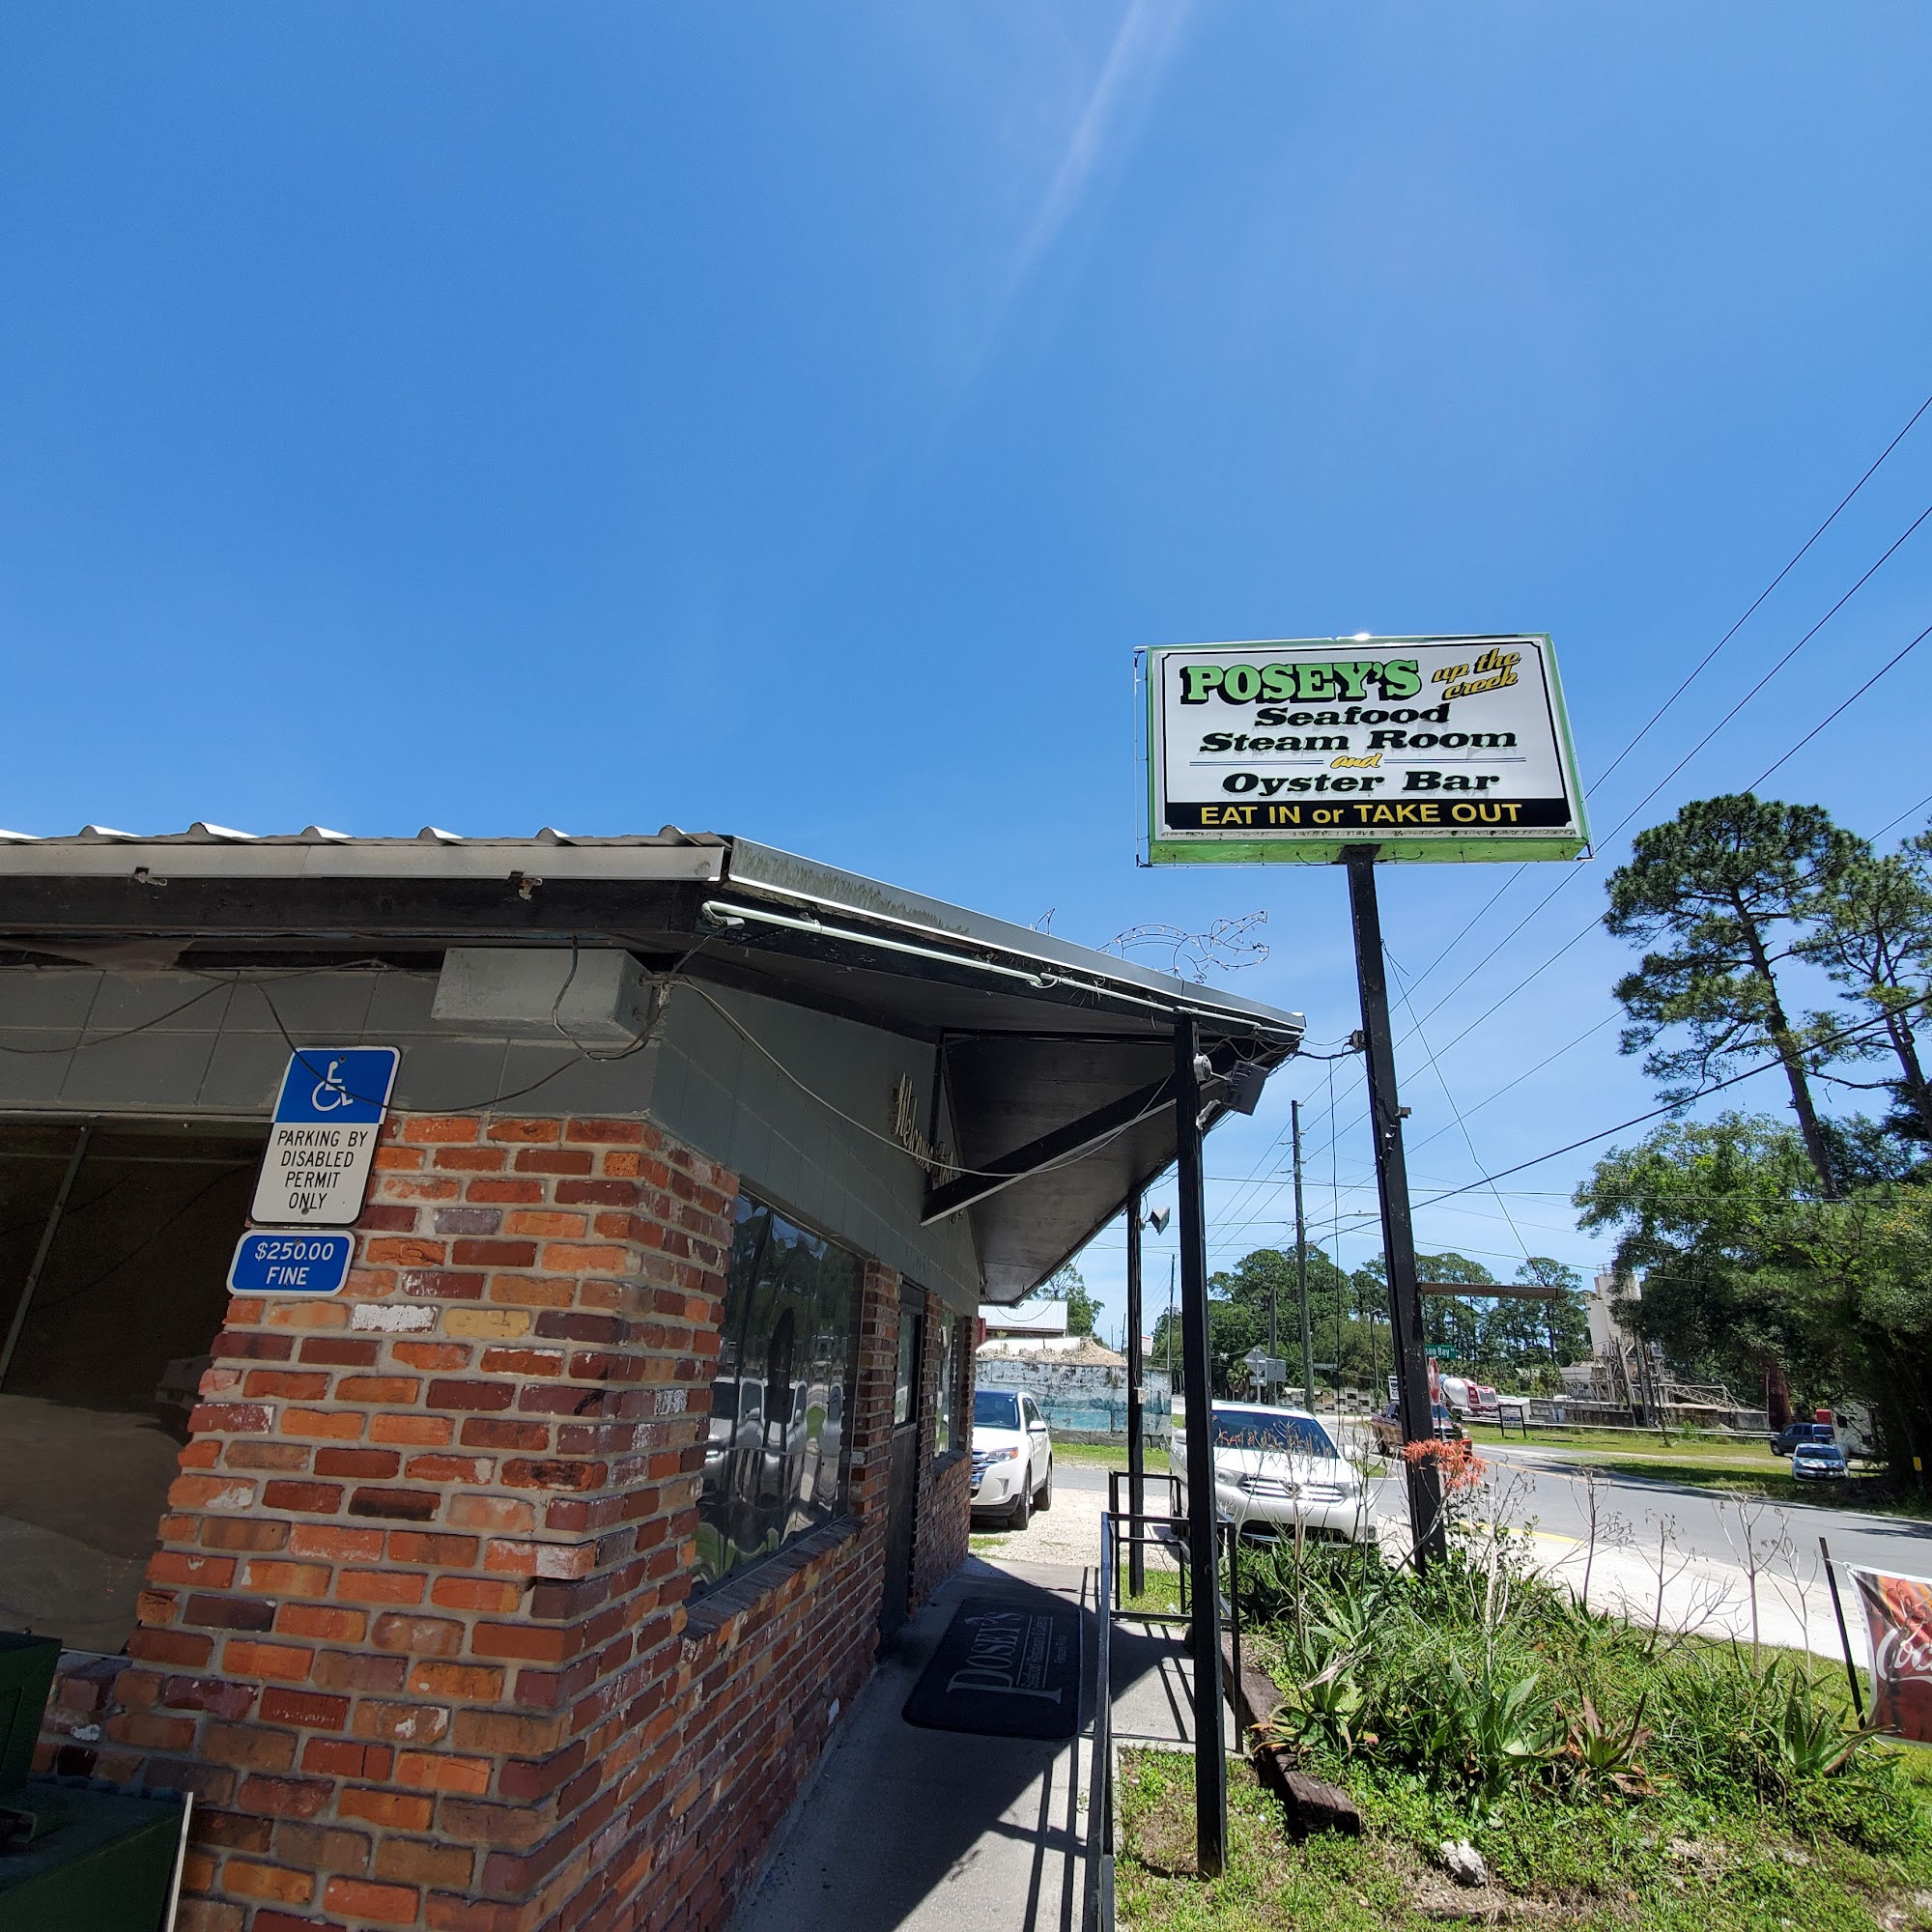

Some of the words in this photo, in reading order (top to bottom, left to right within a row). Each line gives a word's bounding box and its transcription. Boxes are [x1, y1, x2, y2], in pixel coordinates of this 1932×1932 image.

[1432, 664, 1470, 684] up
[1473, 646, 1522, 674] the
[1179, 660, 1422, 705] POSEY'S
[1441, 665, 1519, 700] creek
[1254, 702, 1450, 726] Seafood
[1200, 732, 1350, 753] Steam
[1367, 729, 1517, 750] Room
[1330, 753, 1382, 769] and
[1222, 773, 1385, 797] Oyster
[1402, 771, 1499, 791] Bar
[1201, 806, 1258, 825] EAT
[1268, 806, 1300, 824] IN
[1312, 809, 1344, 824] or
[1352, 804, 1440, 823] TAKE
[1451, 803, 1521, 822] OUT
[276, 1130, 341, 1147] PARKING
[347, 1131, 369, 1147] BY
[280, 1151, 355, 1167] DISABLED
[285, 1171, 341, 1188] PERMIT
[288, 1192, 328, 1209] ONLY
[254, 1241, 334, 1262] $250.00
[266, 1266, 310, 1285] FINE
[1437, 1348, 1450, 1358] Bay
